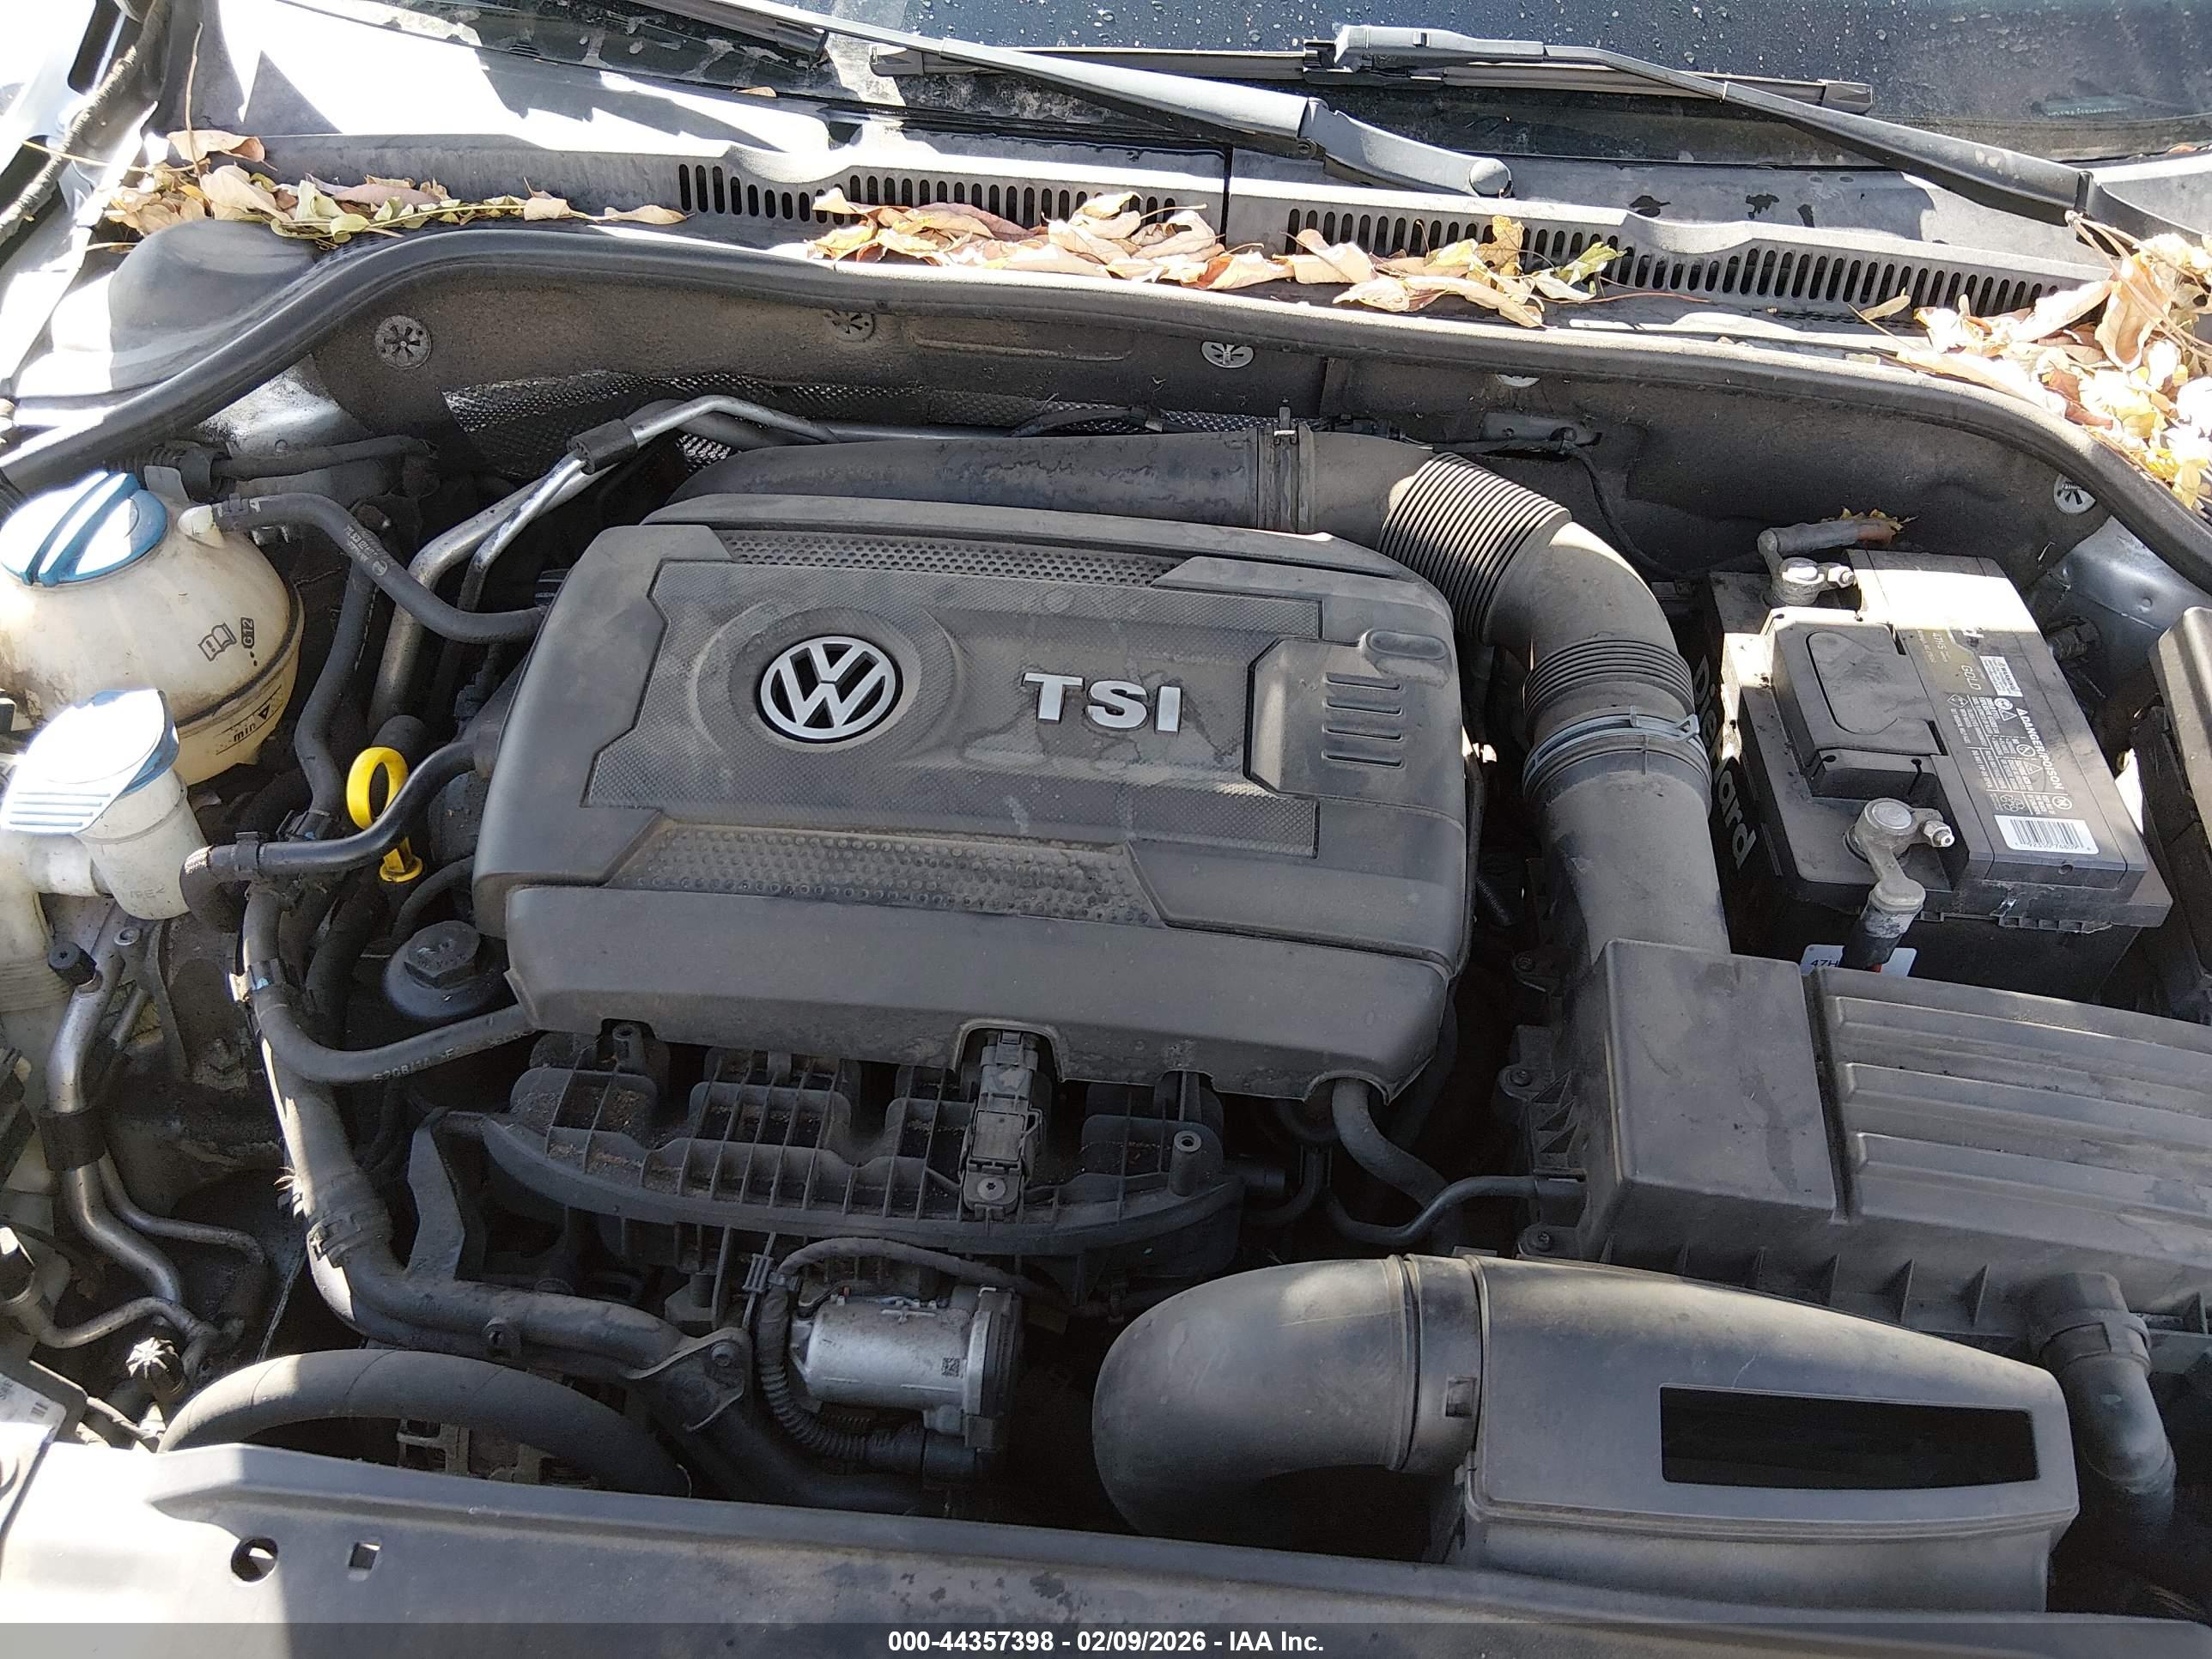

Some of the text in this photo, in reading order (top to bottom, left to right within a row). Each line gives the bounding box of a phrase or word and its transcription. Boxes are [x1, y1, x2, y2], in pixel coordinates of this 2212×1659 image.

[241, 618, 254, 646] G12
[761, 635, 897, 741] VW
[1960, 664, 1982, 690] GOLD
[1023, 672, 1183, 734] TSI
[233, 723, 256, 743] min
[2020, 715, 2065, 790] DANGER/POISON
